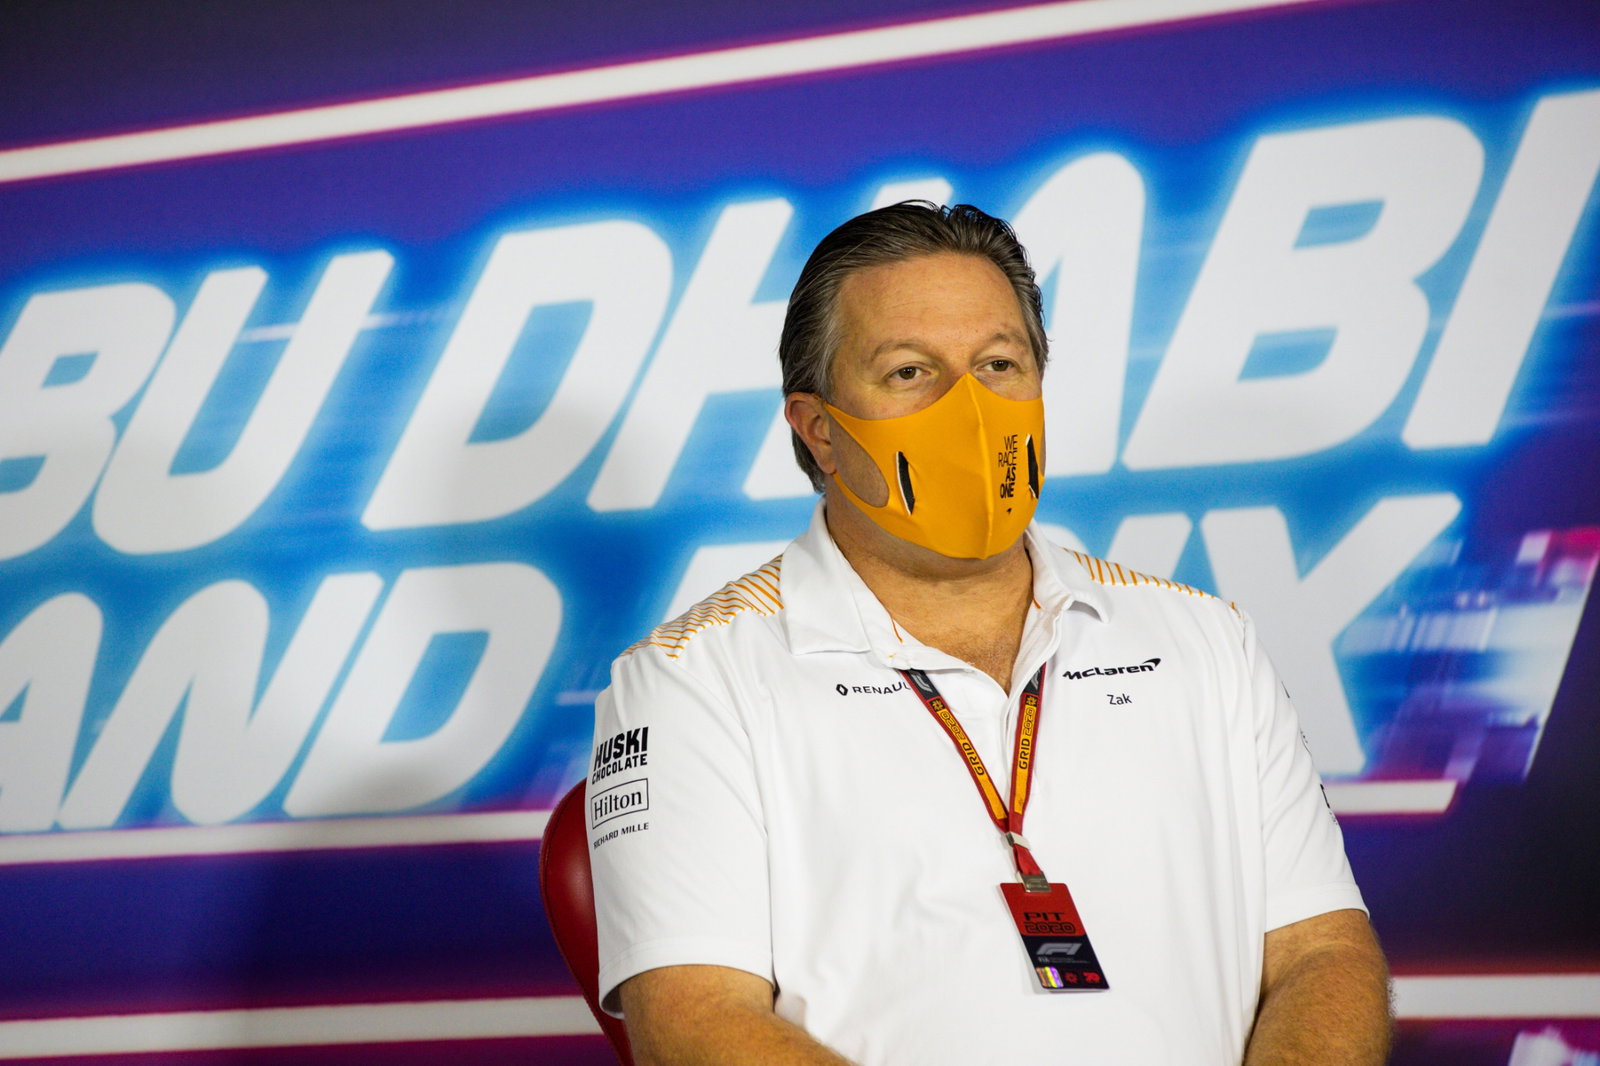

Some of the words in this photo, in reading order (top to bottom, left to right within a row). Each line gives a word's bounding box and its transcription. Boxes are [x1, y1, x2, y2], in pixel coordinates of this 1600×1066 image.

[1003, 434, 1018, 451] WE
[998, 450, 1017, 468] RACE
[1006, 466, 1016, 482] AS
[1000, 482, 1015, 499] ONE
[851, 681, 911, 695] RENAUL
[1106, 693, 1133, 706] Zak
[939, 708, 966, 740] 2020
[1022, 707, 1035, 737] 2020
[593, 726, 649, 772] HUSKI
[961, 742, 985, 776] GRID
[1018, 738, 1031, 770] GRID
[592, 753, 648, 785] CHOCOLATE
[594, 790, 642, 821] Hilton
[593, 829, 619, 850] RICHARD
[620, 822, 649, 835] MILLE
[1023, 911, 1065, 921] PIT
[1023, 921, 1077, 934] 2020
